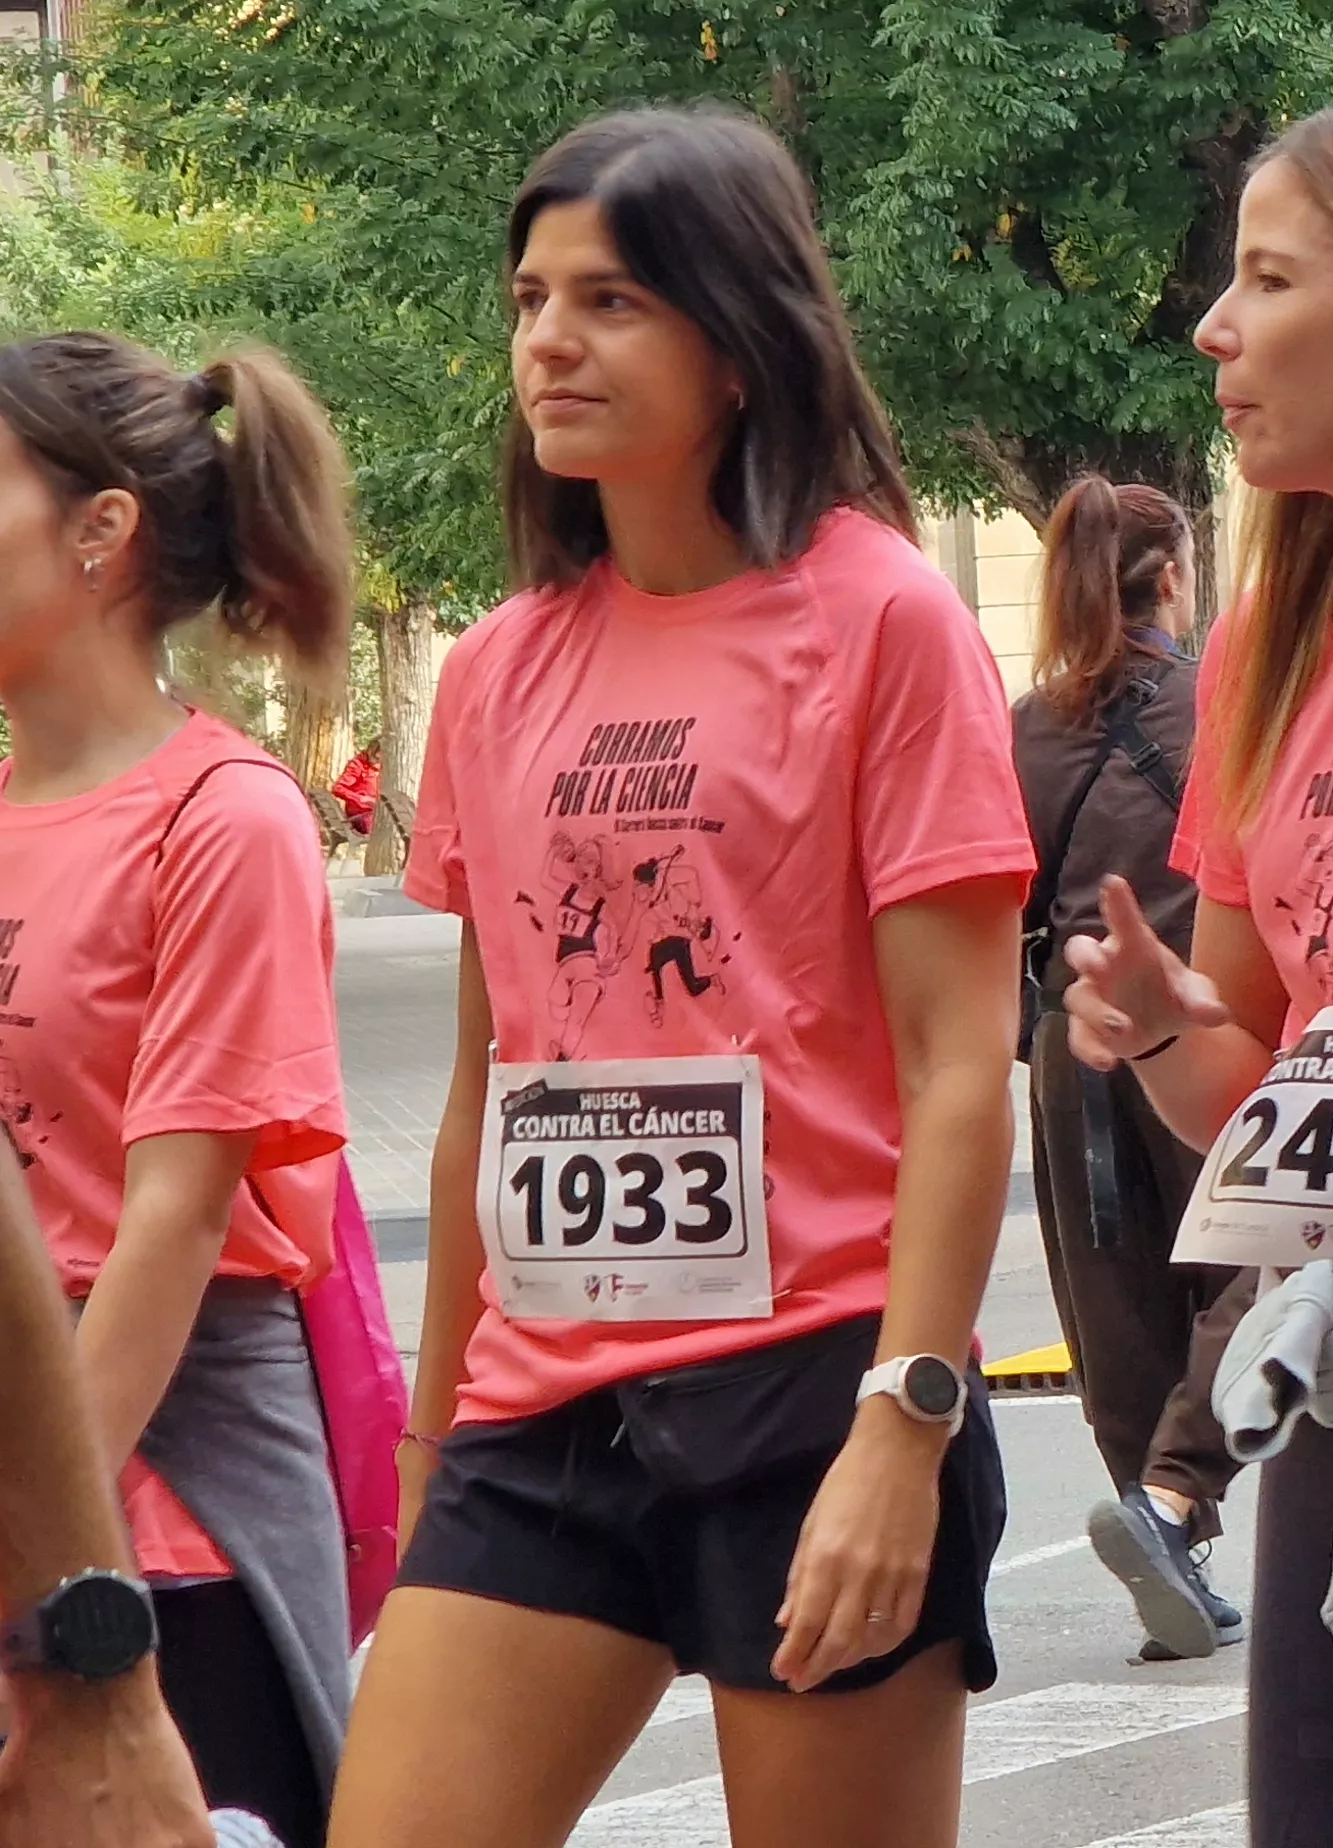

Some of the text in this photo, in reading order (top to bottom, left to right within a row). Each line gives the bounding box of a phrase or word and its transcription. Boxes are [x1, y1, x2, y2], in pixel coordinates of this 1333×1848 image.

[578, 716, 697, 768] CORRAMOS
[545, 763, 699, 818] POR LA CIENCIA
[512, 1106, 727, 1139] CONTRA EL CÁNCER
[579, 1092, 641, 1111] HUESCA
[509, 1150, 733, 1246] 1933
